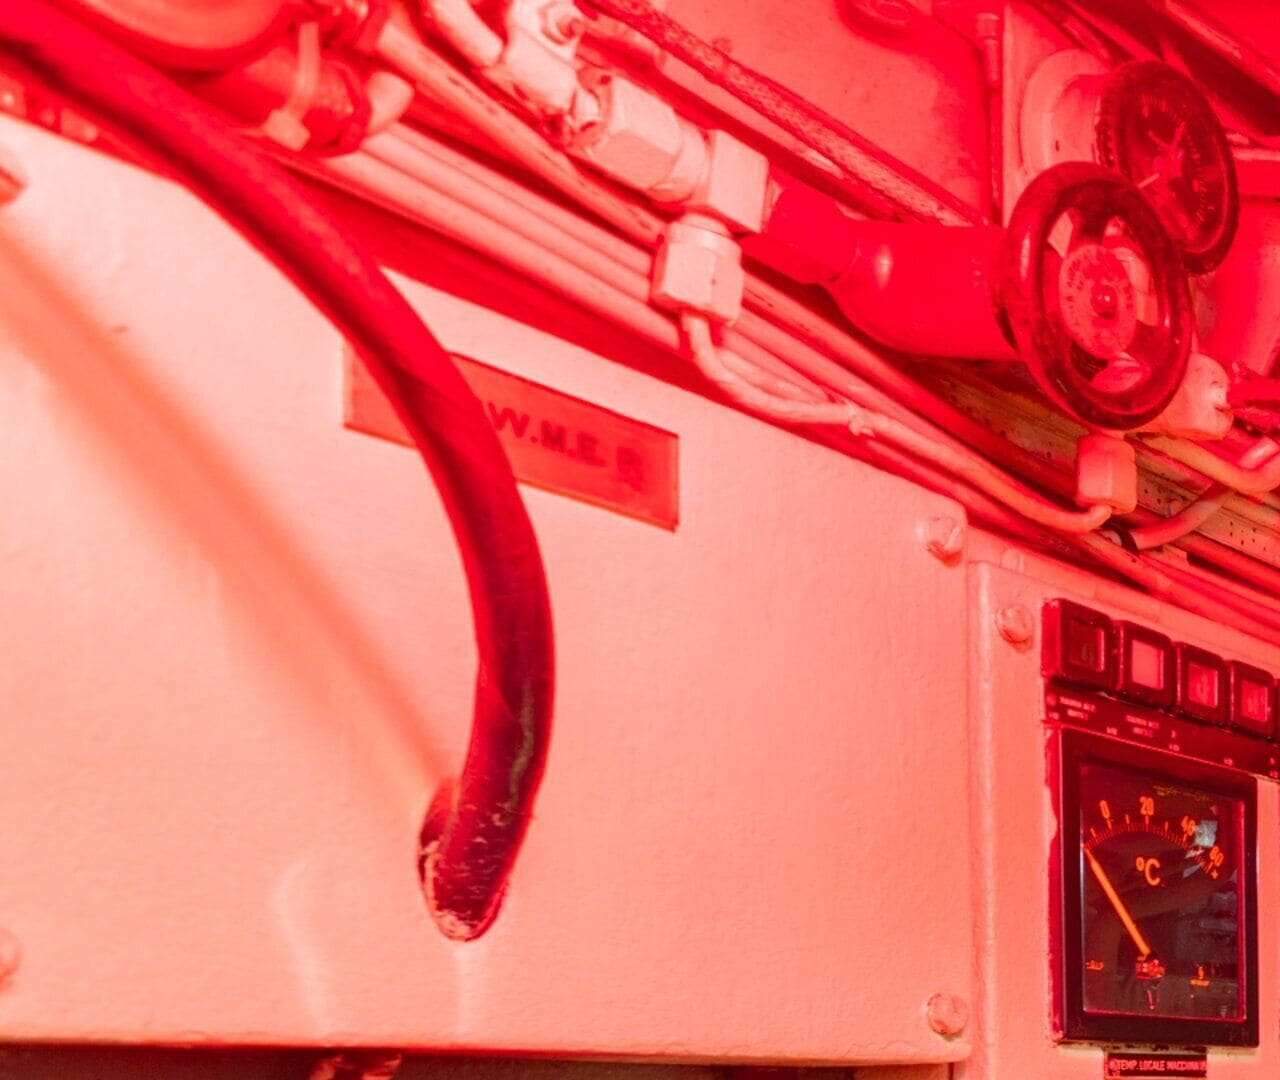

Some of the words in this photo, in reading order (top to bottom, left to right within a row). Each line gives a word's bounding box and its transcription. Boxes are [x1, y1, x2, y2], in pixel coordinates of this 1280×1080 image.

[1100, 800, 1111, 819] 0
[1139, 796, 1154, 816] 20
[1139, 1060, 1165, 1072] LOCALE
